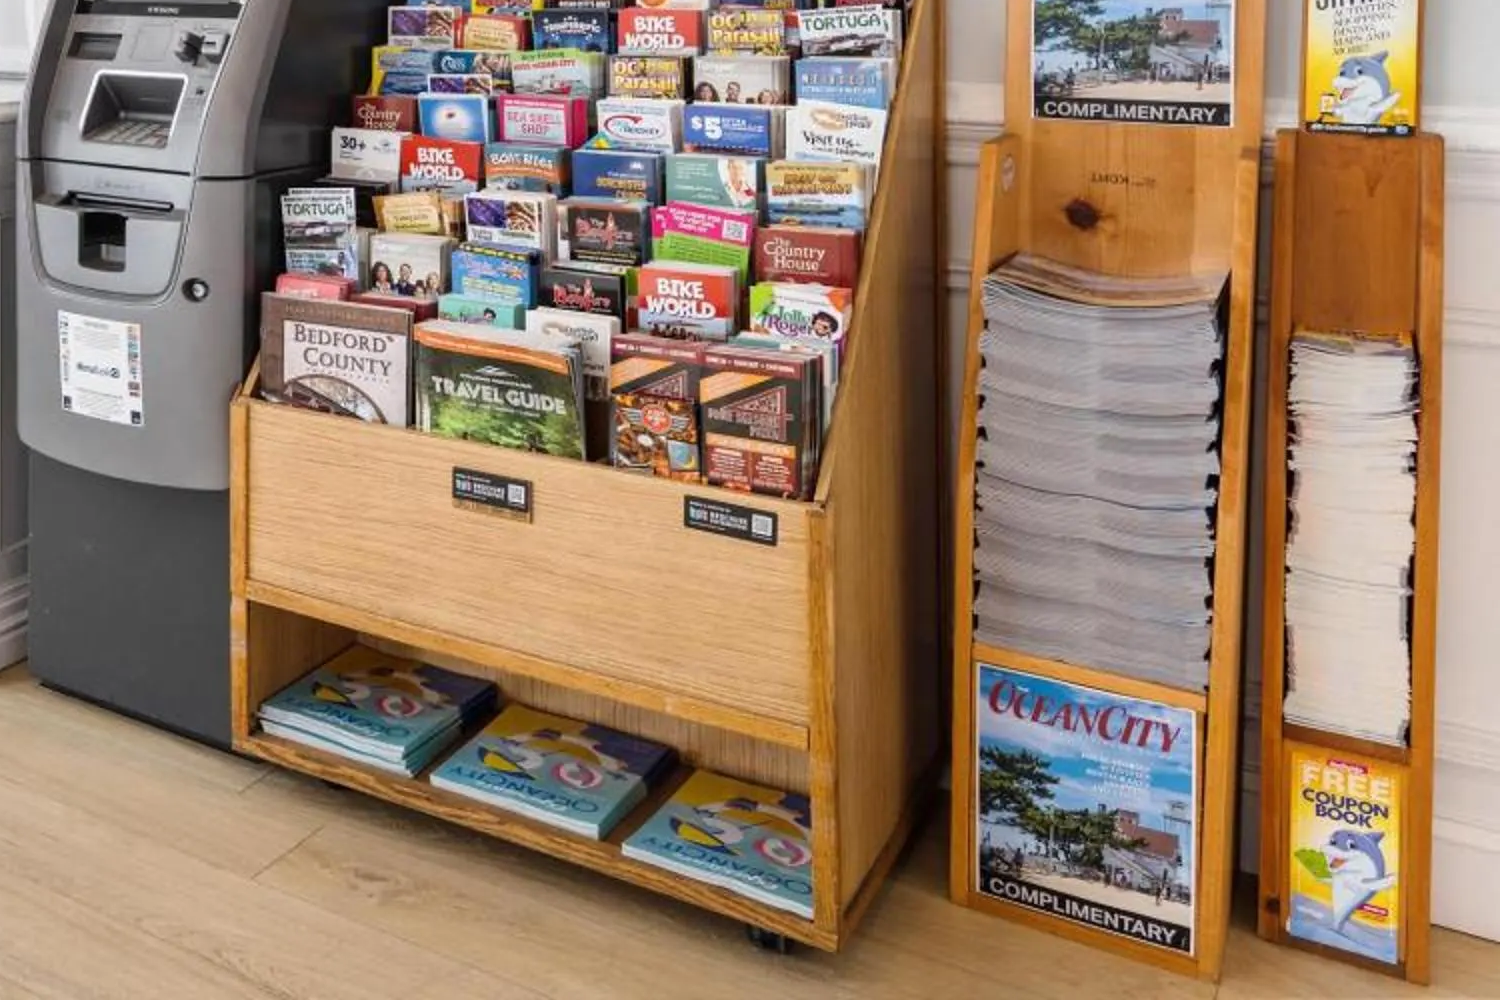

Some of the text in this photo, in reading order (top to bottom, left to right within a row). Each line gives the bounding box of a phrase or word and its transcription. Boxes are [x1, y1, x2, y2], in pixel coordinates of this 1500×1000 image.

[634, 16, 676, 33] BIKE
[711, 14, 737, 30] OC
[804, 13, 881, 32] TORTUGA
[625, 33, 685, 50] WORLD
[615, 60, 637, 74] OC
[358, 106, 402, 121] Country
[507, 111, 528, 121] SEA
[1043, 100, 1218, 122] COMPLIMENTARY
[521, 125, 549, 136] SHOP
[340, 136, 366, 150] 30+
[417, 147, 455, 164] BIKE
[410, 163, 464, 181] WORLD
[285, 203, 345, 217] TORTUGA
[763, 241, 826, 261] Country
[774, 256, 820, 271] House
[657, 278, 705, 299] BIKE
[646, 296, 715, 319] WORLD
[777, 306, 812, 324] Jolly
[761, 315, 813, 337] Roger
[294, 324, 387, 353] BEDFORD
[303, 348, 392, 377] COUNTY
[431, 375, 503, 404] TRAVEL
[505, 389, 567, 415] GUIDE
[1301, 763, 1392, 803] FREE
[1302, 788, 1390, 820] COUPON
[1315, 804, 1373, 828] BOOK
[989, 877, 1178, 945] COMPLIMENTARY
